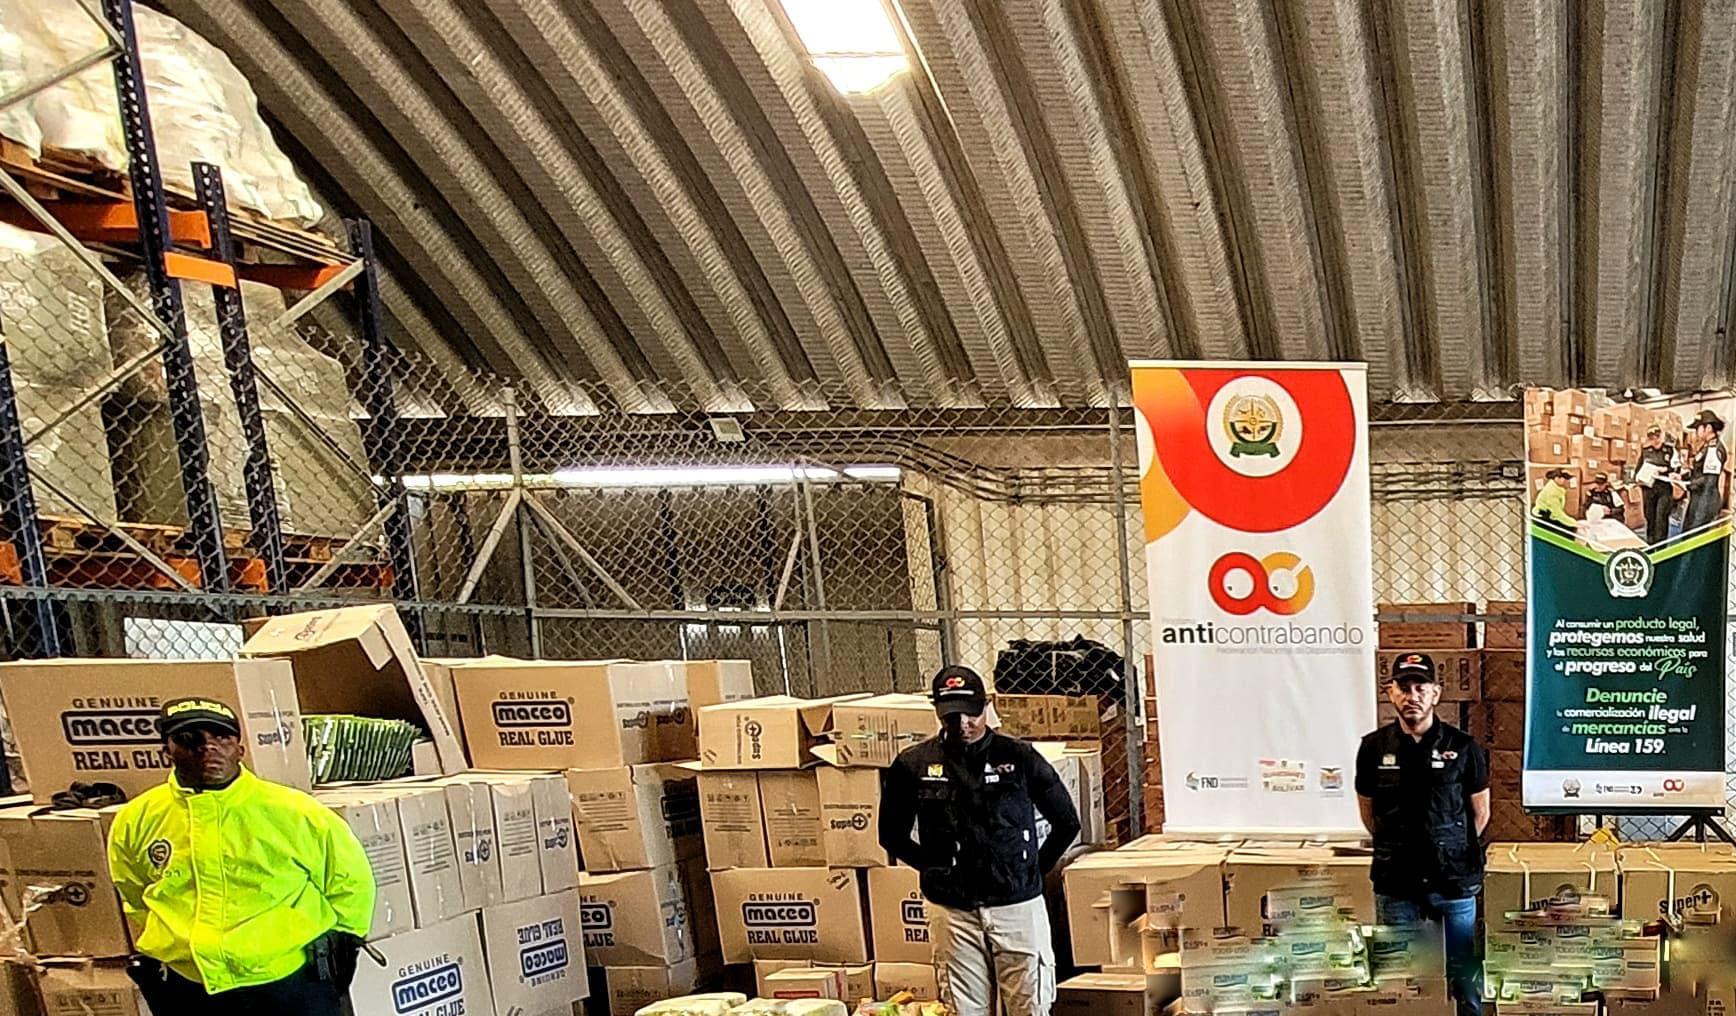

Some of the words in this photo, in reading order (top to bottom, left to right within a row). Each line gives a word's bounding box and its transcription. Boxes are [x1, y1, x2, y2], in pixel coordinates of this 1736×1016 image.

[1555, 619, 1564, 628] Al
[1566, 619, 1601, 629] consumir
[1603, 621, 1614, 629] un
[1616, 616, 1666, 631] producto
[1668, 616, 1700, 632] legal,
[1162, 621, 1364, 645] anticontrabando
[1549, 630, 1645, 646] protegemos
[1645, 634, 1675, 643] nuestra
[1678, 631, 1706, 643] salud
[1553, 647, 1566, 657] los
[1567, 647, 1615, 657] recursos
[1617, 644, 1687, 658] económicos
[1688, 650, 1708, 659] para
[1555, 661, 1563, 671] el
[1565, 660, 1637, 676] progreso
[1639, 662, 1653, 672] del
[1654, 655, 1698, 681] País
[72, 696, 162, 709] GENUINE
[499, 691, 558, 700] GENUINE
[1586, 687, 1668, 704] Denuncie
[498, 705, 565, 721] maceo
[1564, 705, 1646, 718] comercialización
[1648, 704, 1697, 724] ilegal
[1571, 720, 1667, 735] mercancías
[499, 730, 535, 746] REAL
[538, 730, 574, 746] GLUE
[1586, 738, 1630, 754] Línea
[1634, 738, 1667, 755] 159.
[73, 751, 129, 770] REAL
[749, 892, 804, 901] GENUINE
[1659, 888, 1714, 914] Sper+
[748, 906, 811, 921] maceo
[516, 921, 543, 945] GLUE
[541, 917, 565, 940] REAL
[904, 928, 930, 943] REA
[584, 932, 615, 947] LUE
[748, 930, 782, 944] REAL
[783, 930, 818, 943] GLUE
[398, 952, 451, 978] GENUINE
[522, 944, 568, 972] maceo
[398, 968, 459, 1006] maceo
